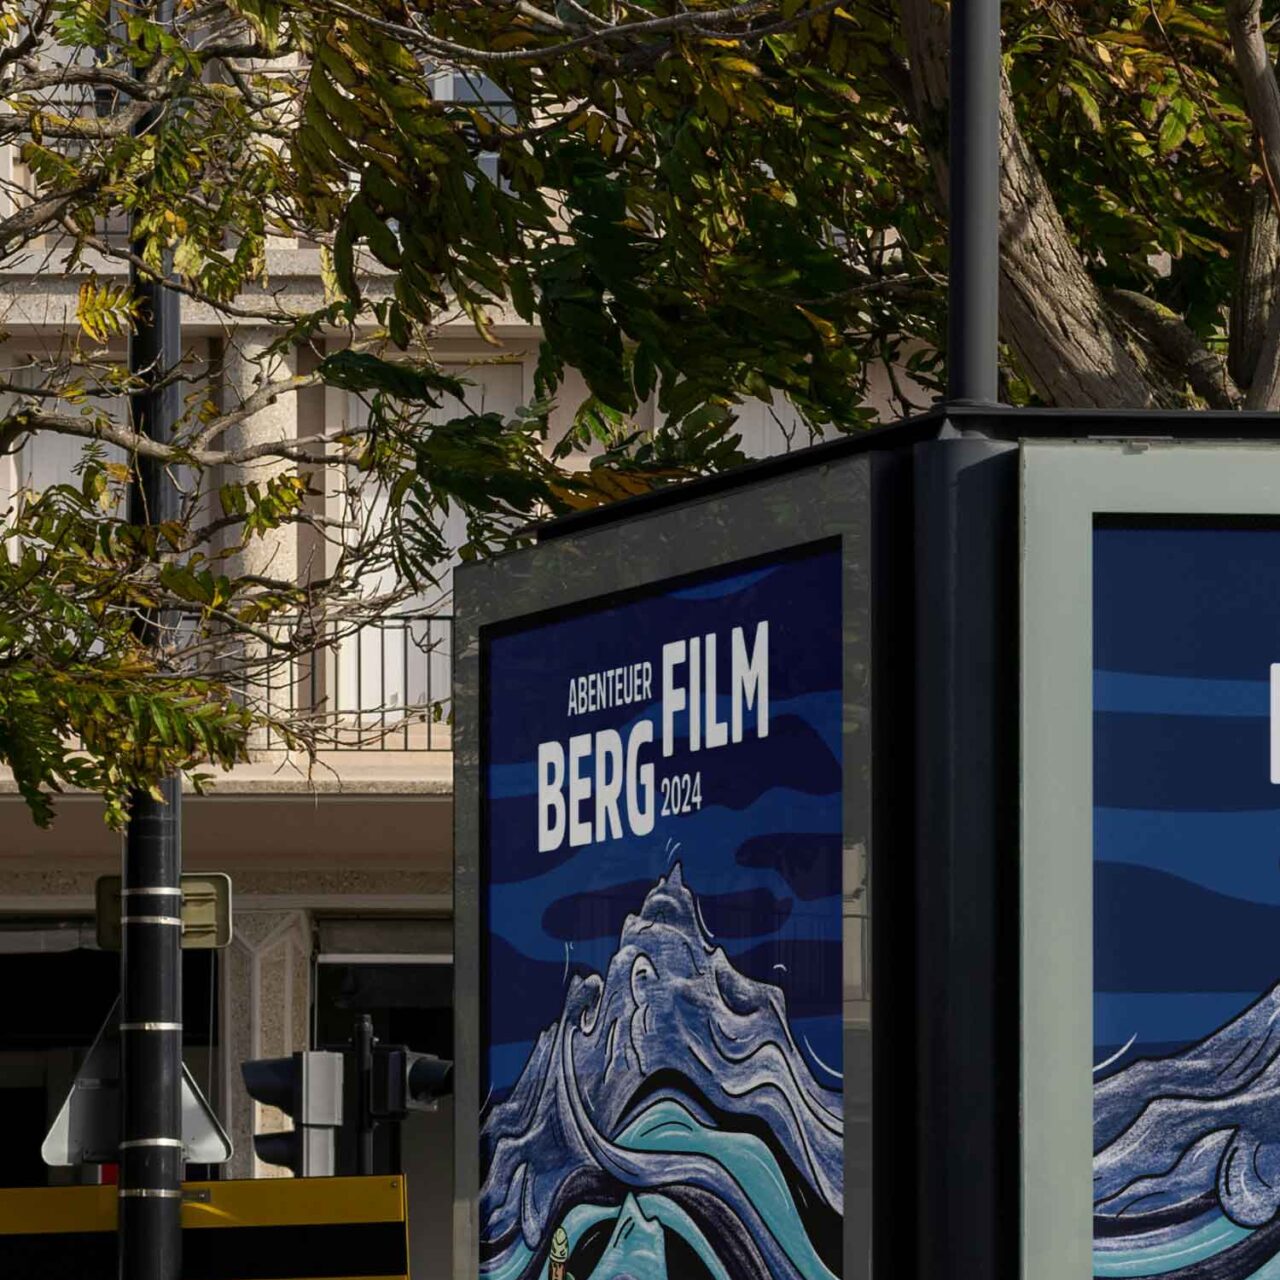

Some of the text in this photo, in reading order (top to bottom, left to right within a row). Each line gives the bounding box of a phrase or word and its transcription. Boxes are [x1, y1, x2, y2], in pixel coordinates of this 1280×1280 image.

[568, 661, 652, 716] ABENTEUER
[663, 620, 769, 757] FILM
[538, 719, 655, 853] BERG
[660, 771, 702, 816] 2024
